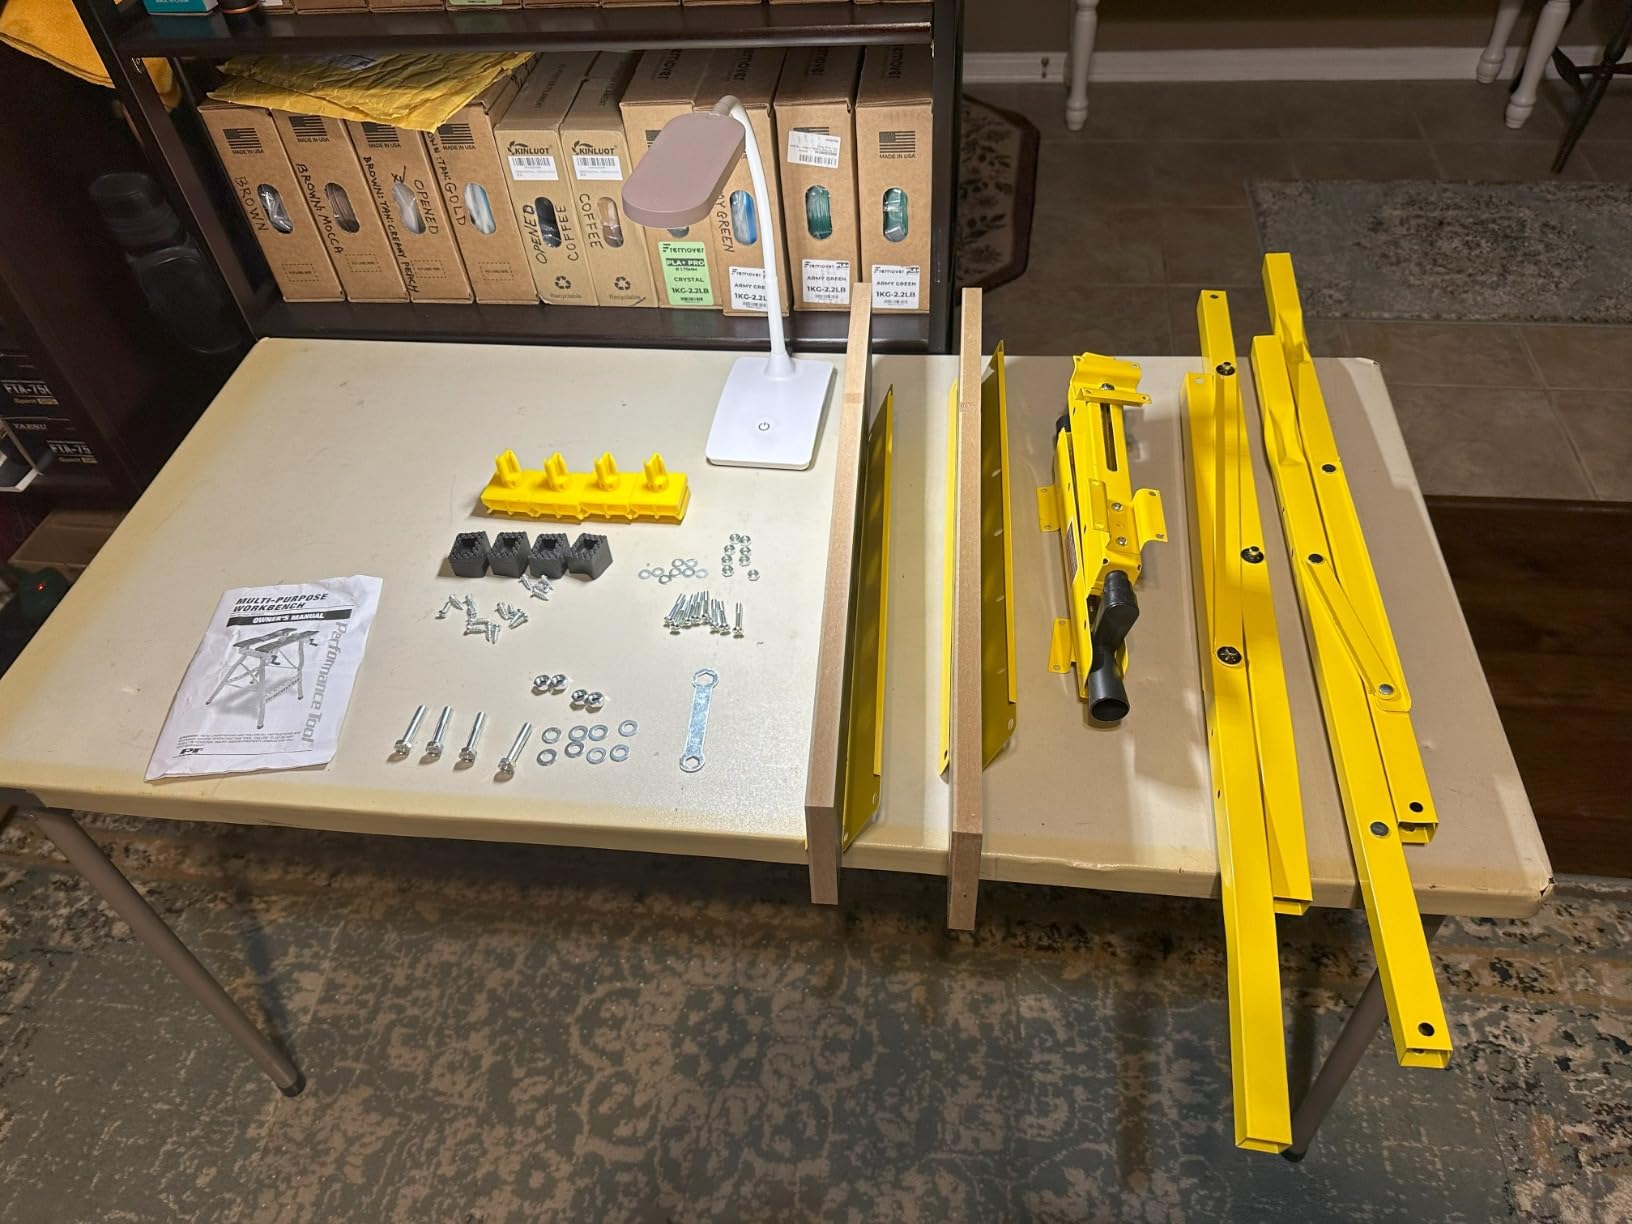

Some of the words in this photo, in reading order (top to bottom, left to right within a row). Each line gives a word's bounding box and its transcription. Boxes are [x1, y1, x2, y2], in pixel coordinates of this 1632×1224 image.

[514, 147, 550, 155] KINLUOT
[579, 147, 615, 155] KINLUOT
[235, 176, 269, 231] BROWN
[414, 179, 439, 235] OPENED
[445, 182, 466, 226] GOLD
[579, 193, 603, 249] COFFEE
[318, 214, 344, 254] MOCCA
[522, 204, 548, 264] OPENED
[556, 204, 579, 261] COFFEE
[716, 210, 735, 253] GREEN
[401, 261, 421, 293] PEACH
[734, 293, 767, 301] 1KG-2.2L
[233, 602, 306, 612] WORKBENCH
[236, 593, 328, 605] MULTI-PURPOSE
[253, 615, 289, 624] OWNER'S
[291, 612, 324, 620] MANUAL
[310, 621, 348, 710] Performance
[302, 713, 322, 743] Tool
